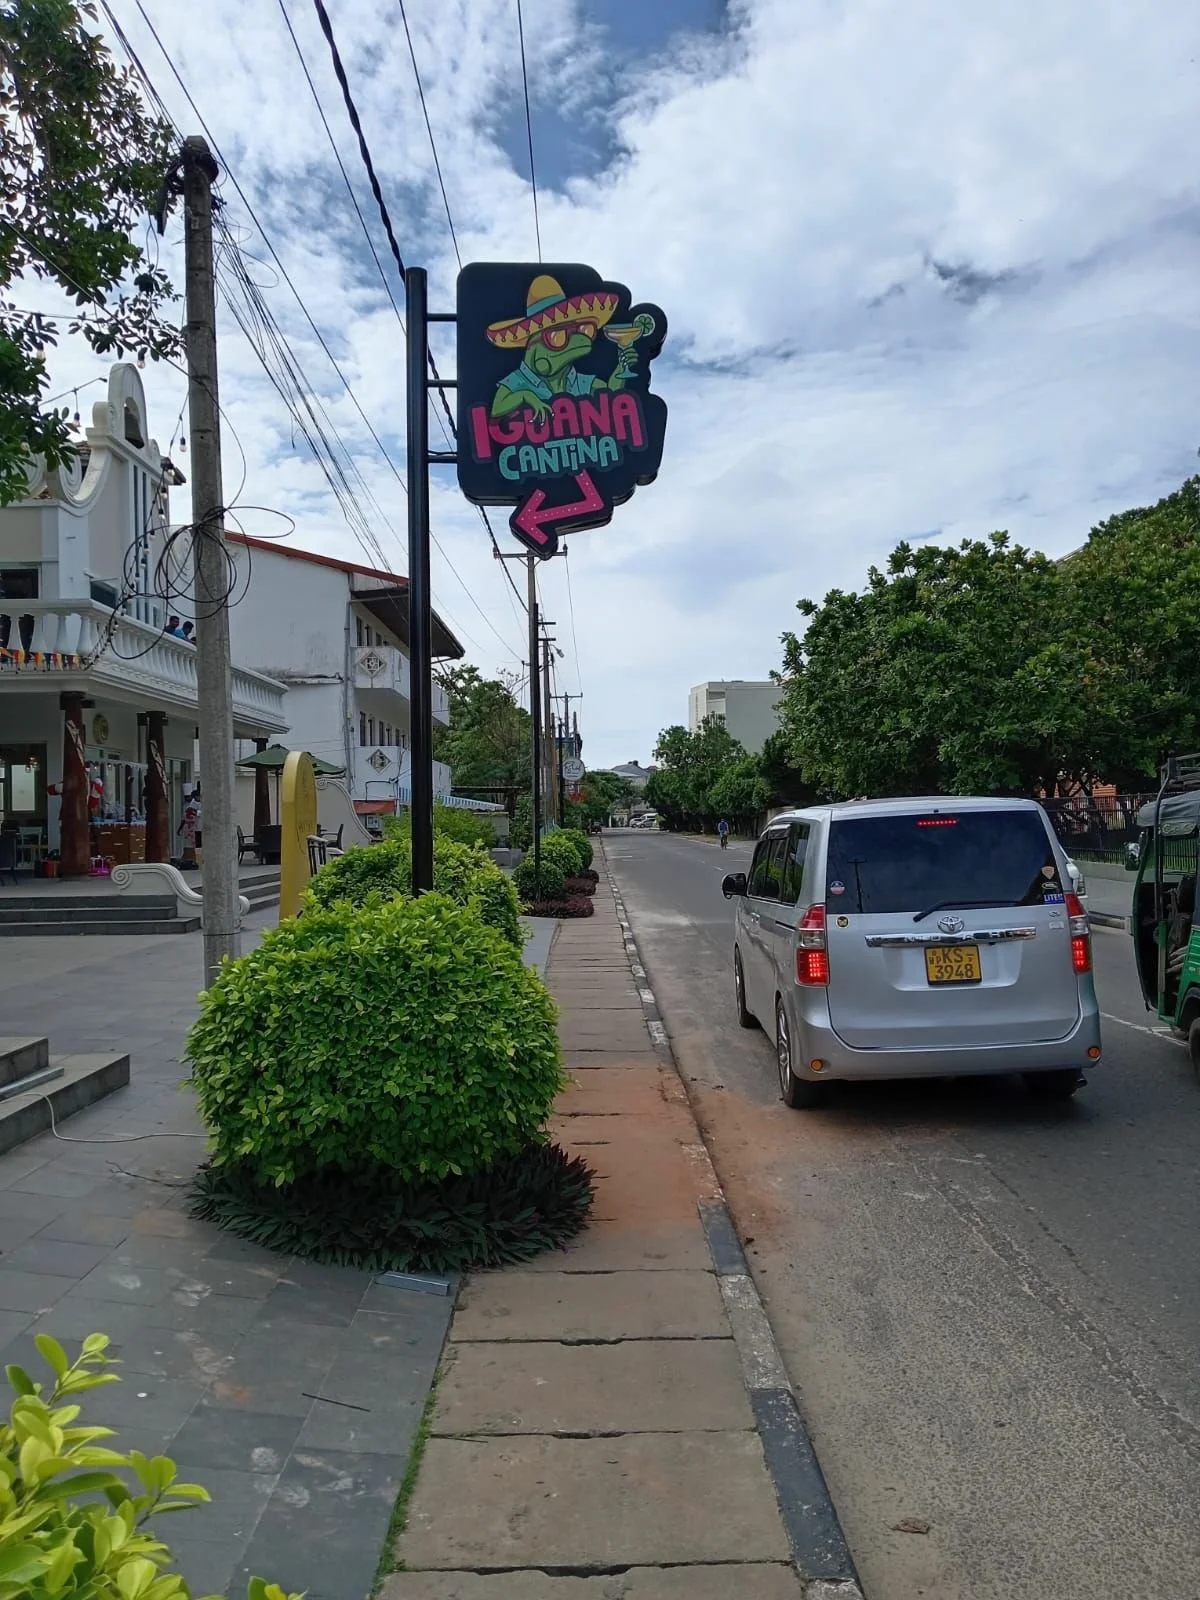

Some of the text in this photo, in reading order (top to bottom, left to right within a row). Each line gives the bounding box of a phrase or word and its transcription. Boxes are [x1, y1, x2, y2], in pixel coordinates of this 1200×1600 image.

[472, 394, 642, 458] IGUANA
[499, 437, 619, 480] CANTINA
[942, 948, 963, 963] KS
[935, 963, 974, 979] 3948
